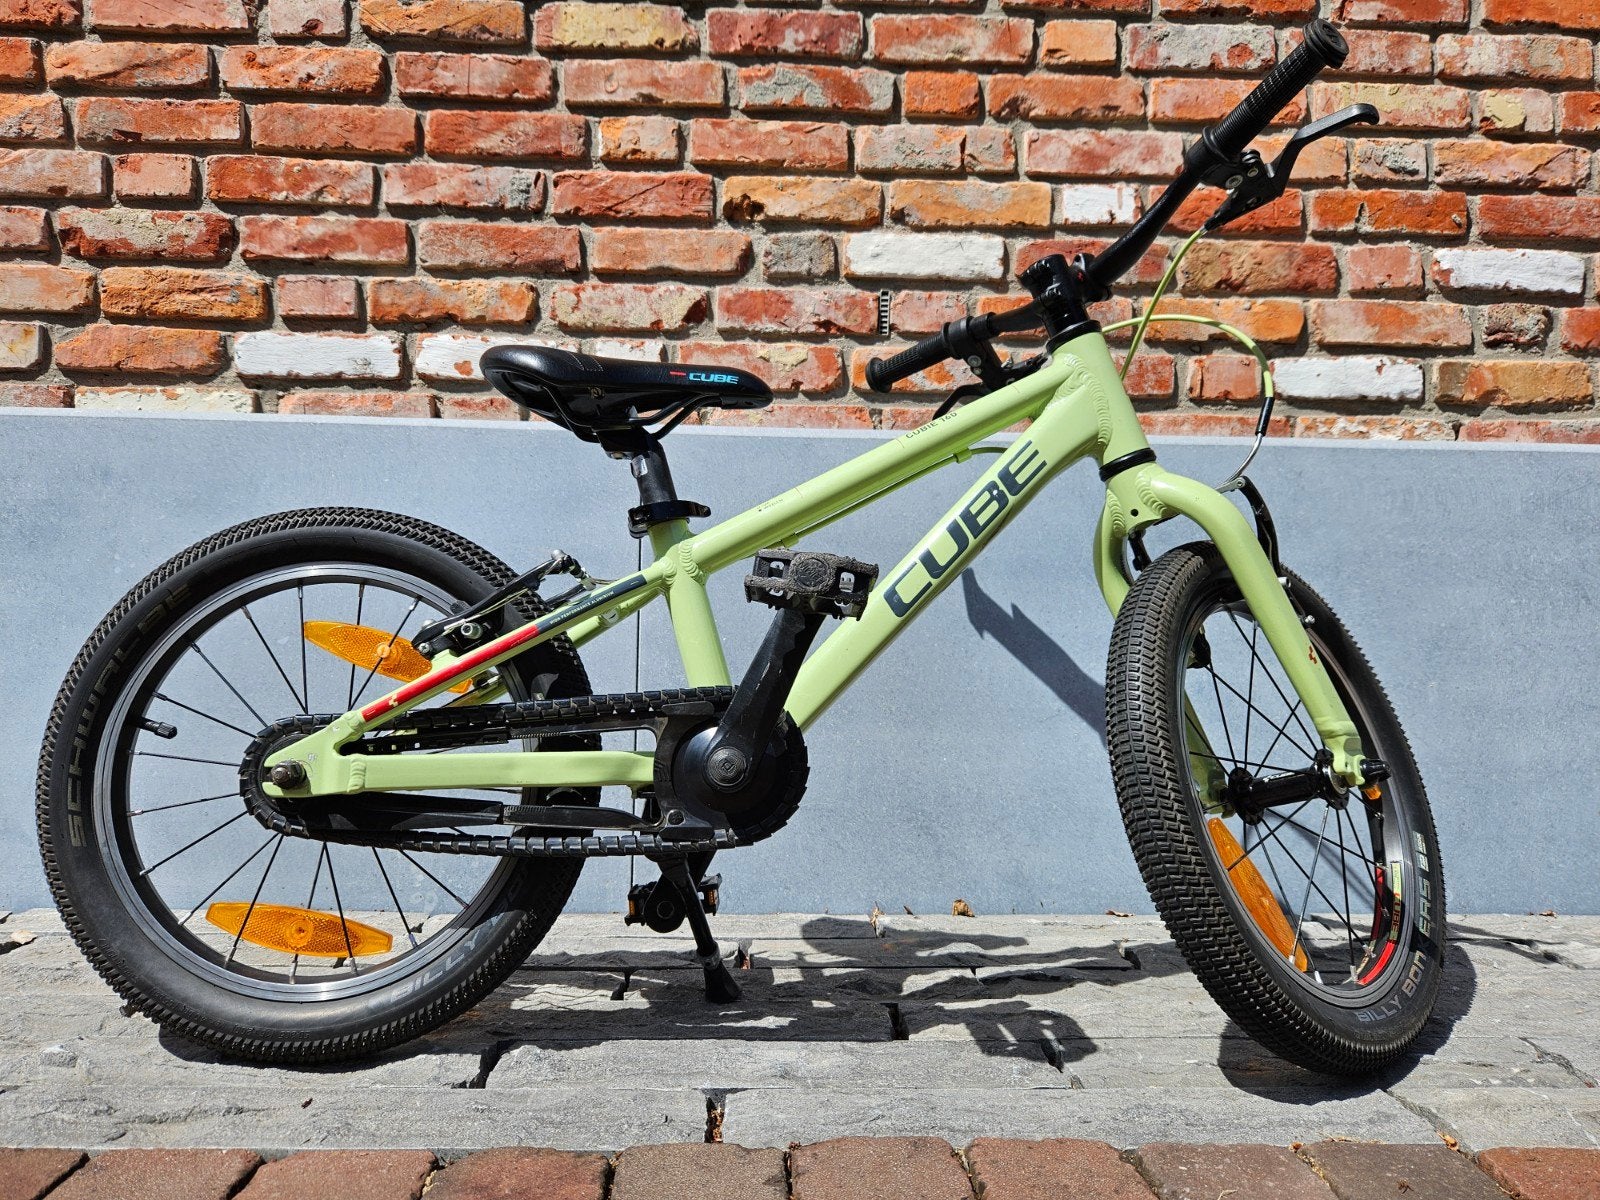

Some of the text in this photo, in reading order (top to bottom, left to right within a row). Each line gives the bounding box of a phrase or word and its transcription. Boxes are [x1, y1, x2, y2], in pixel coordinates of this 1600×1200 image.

[689, 372, 739, 385] CUBE
[905, 412, 957, 439] CUBIE 160
[883, 440, 1047, 617] CUBE
[67, 583, 192, 847] SCHWALBE
[391, 929, 481, 1002] BILLY
[1355, 995, 1402, 1022] BILLY
